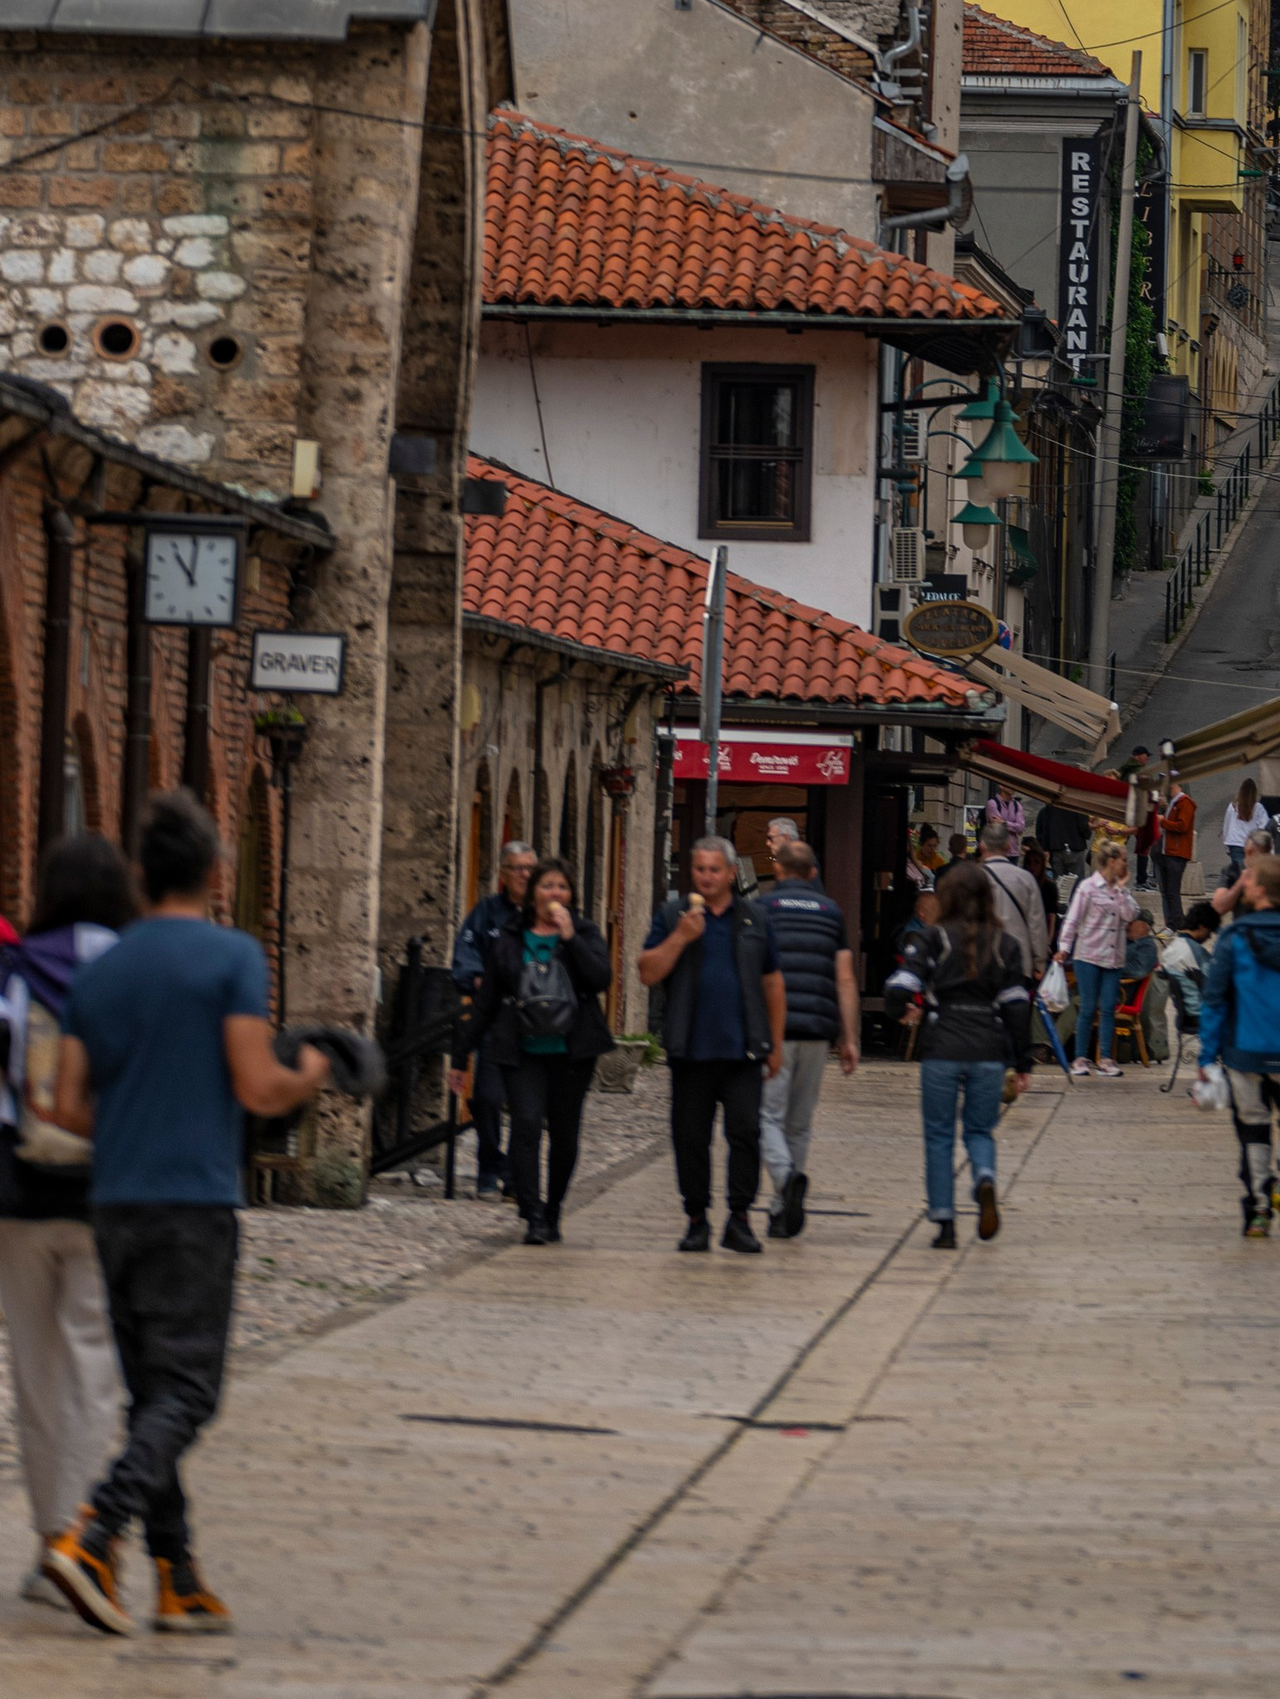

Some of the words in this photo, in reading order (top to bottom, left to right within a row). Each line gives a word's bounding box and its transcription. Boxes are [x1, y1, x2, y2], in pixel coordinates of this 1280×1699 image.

[1067, 151, 1091, 379] RESTAURANT
[1140, 181, 1156, 310] LIBER
[260, 651, 339, 676] GRAVER
